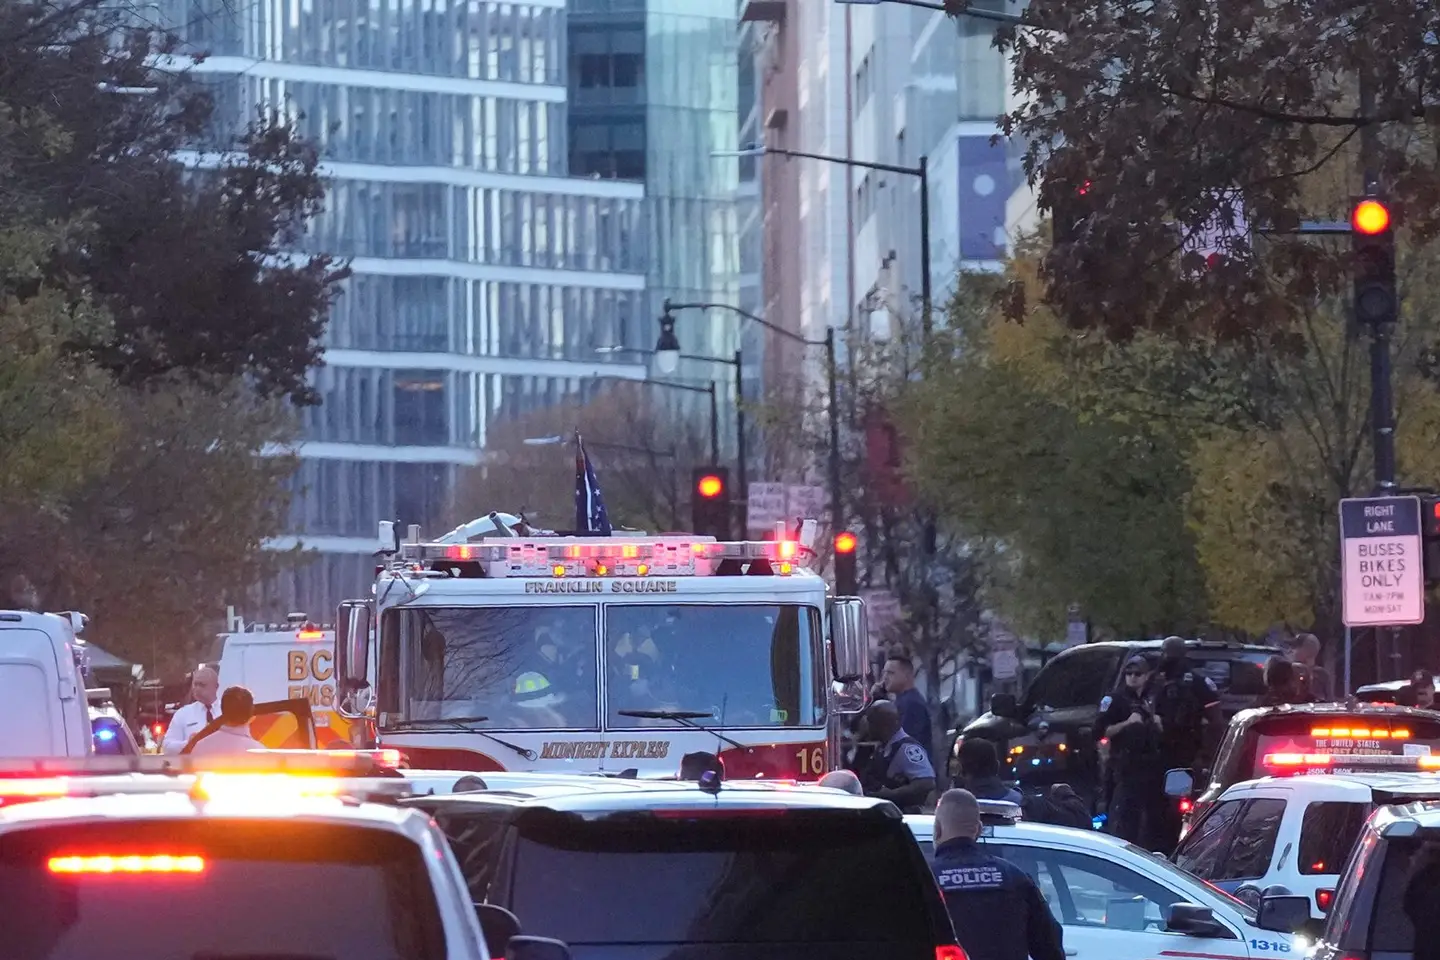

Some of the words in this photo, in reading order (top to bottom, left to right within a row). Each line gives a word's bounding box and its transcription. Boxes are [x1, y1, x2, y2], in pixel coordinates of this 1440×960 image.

[1364, 505, 1395, 517] RIGHT
[1367, 520, 1395, 532] LANE
[1358, 543, 1405, 557] BUSES
[1360, 559, 1406, 573] BIKES
[525, 581, 604, 593] FRANKLIN
[611, 581, 677, 592] SQUARE
[1362, 574, 1403, 587] ONLY
[540, 742, 609, 759] MIDNIGHT
[612, 741, 670, 758] EXPRESS
[1331, 740, 1354, 748] UNITED
[1357, 740, 1380, 748] STATES
[796, 748, 824, 774] 16
[938, 872, 1004, 885] POLICE
[1249, 939, 1291, 953] 1318
